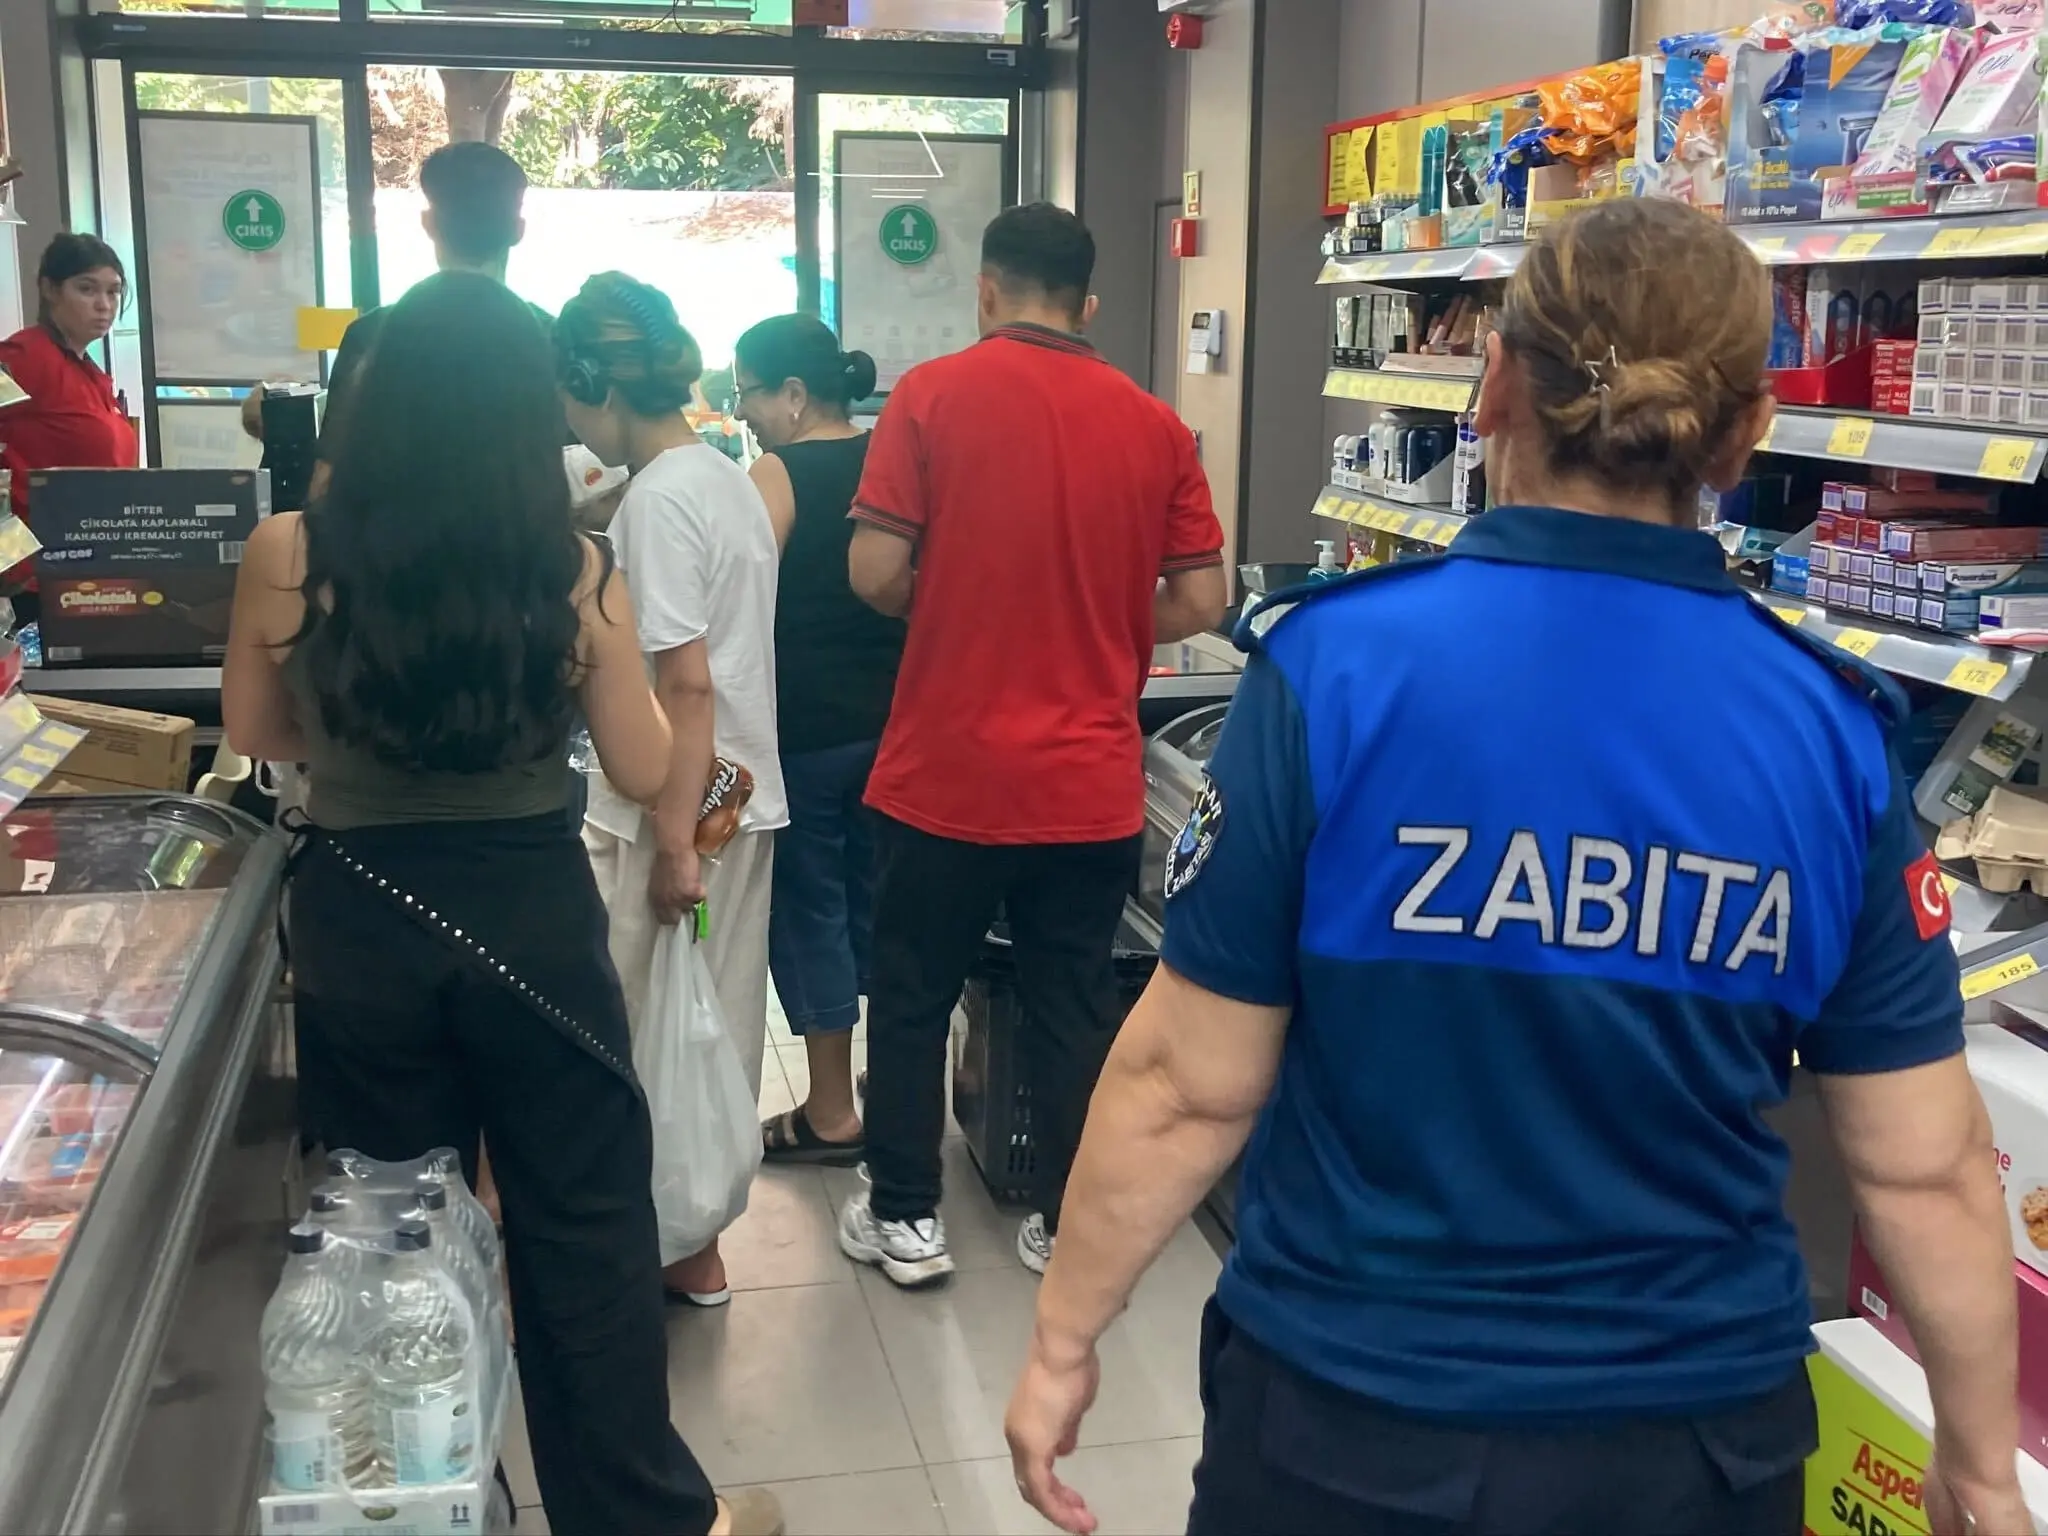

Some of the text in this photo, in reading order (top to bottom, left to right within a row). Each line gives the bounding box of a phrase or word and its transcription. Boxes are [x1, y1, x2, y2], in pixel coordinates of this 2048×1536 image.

[235, 225, 273, 239] ÇIKIŞ
[890, 238, 926, 253] ÇIKIŞ
[124, 504, 163, 515] BİTTER
[80, 517, 208, 530] ÇİKOLATA KAPLAMALI
[65, 530, 224, 541] KAKAOLU KREMALI GOFRET
[1392, 825, 1792, 975] ZABITA
[1998, 963, 2032, 979] 185
[1831, 1486, 1897, 1536] SAR
